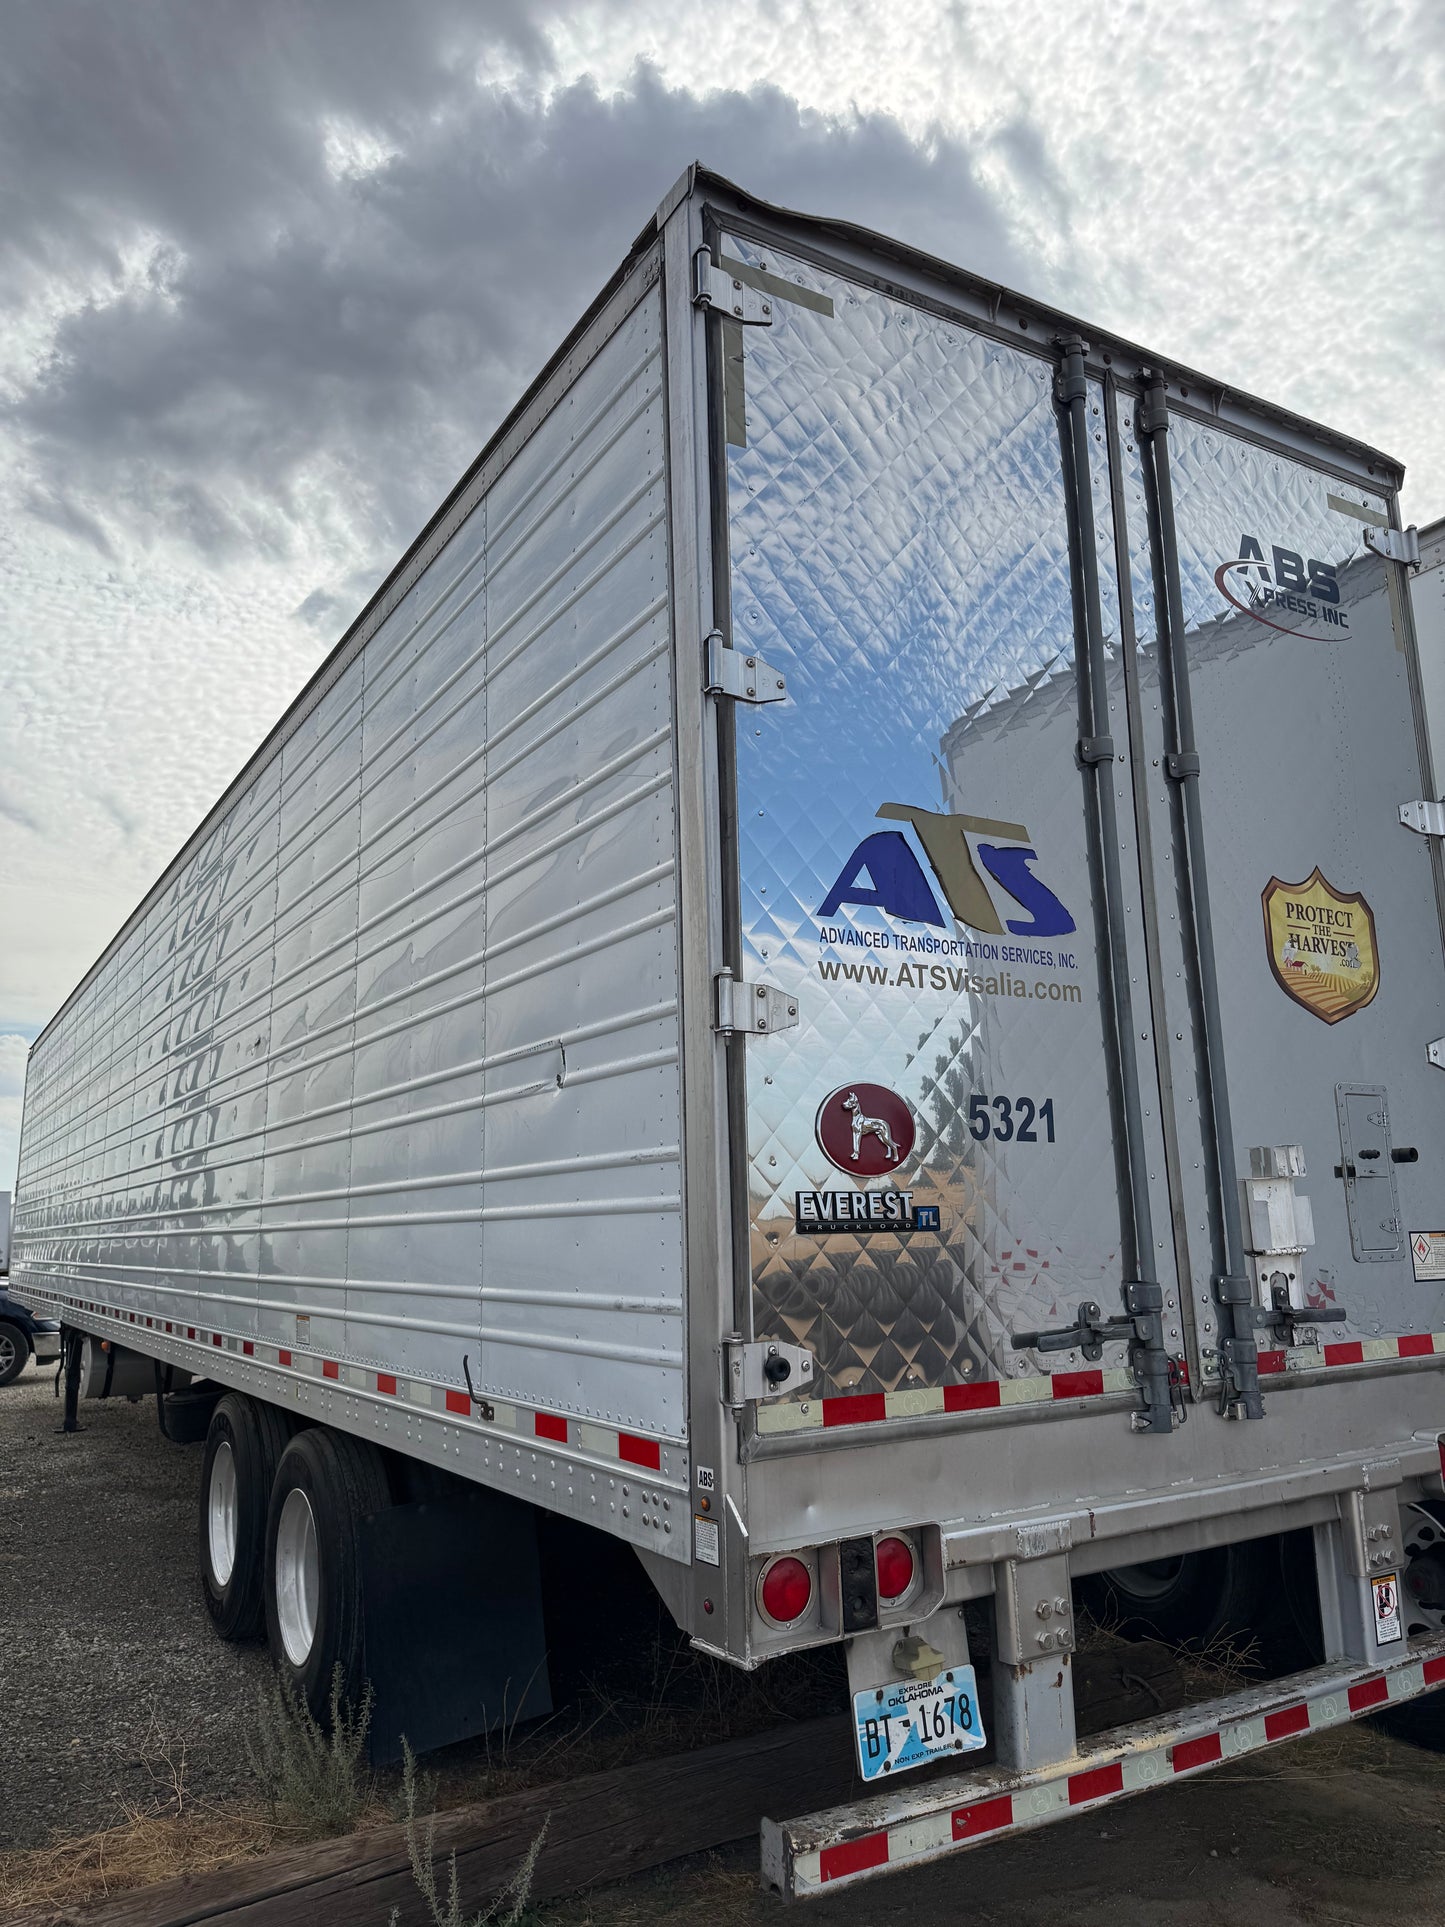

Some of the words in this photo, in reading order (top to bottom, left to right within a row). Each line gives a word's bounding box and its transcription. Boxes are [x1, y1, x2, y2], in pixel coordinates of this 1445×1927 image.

[1236, 533, 1340, 604] ABS
[1245, 580, 1317, 618] XPRESS
[1322, 606, 1349, 629] INC
[816, 803, 1077, 937] ATS
[1285, 902, 1353, 928] PROTECT
[1312, 924, 1331, 937] THE
[819, 927, 889, 949] ADVANCED
[893, 934, 998, 960] TRANSPORTATION
[1001, 946, 1056, 970] SERVICES,
[1058, 953, 1078, 969] INC.
[818, 960, 1082, 1003] www.ATSVisalia.com
[968, 1095, 1056, 1142] 5321
[799, 1191, 913, 1221] EVEREST
[919, 1211, 938, 1226] TL
[804, 1223, 911, 1231] TRUCKLOAD
[698, 1470, 713, 1488] ABS
[888, 1685, 944, 1707] OKLAHOMA
[898, 1681, 933, 1695] EXPLORE
[865, 1714, 892, 1758] BT
[918, 1693, 972, 1743] 1678
[894, 1756, 910, 1765] NON
[911, 1751, 925, 1760] EXP
[925, 1743, 954, 1756] TRAILER
